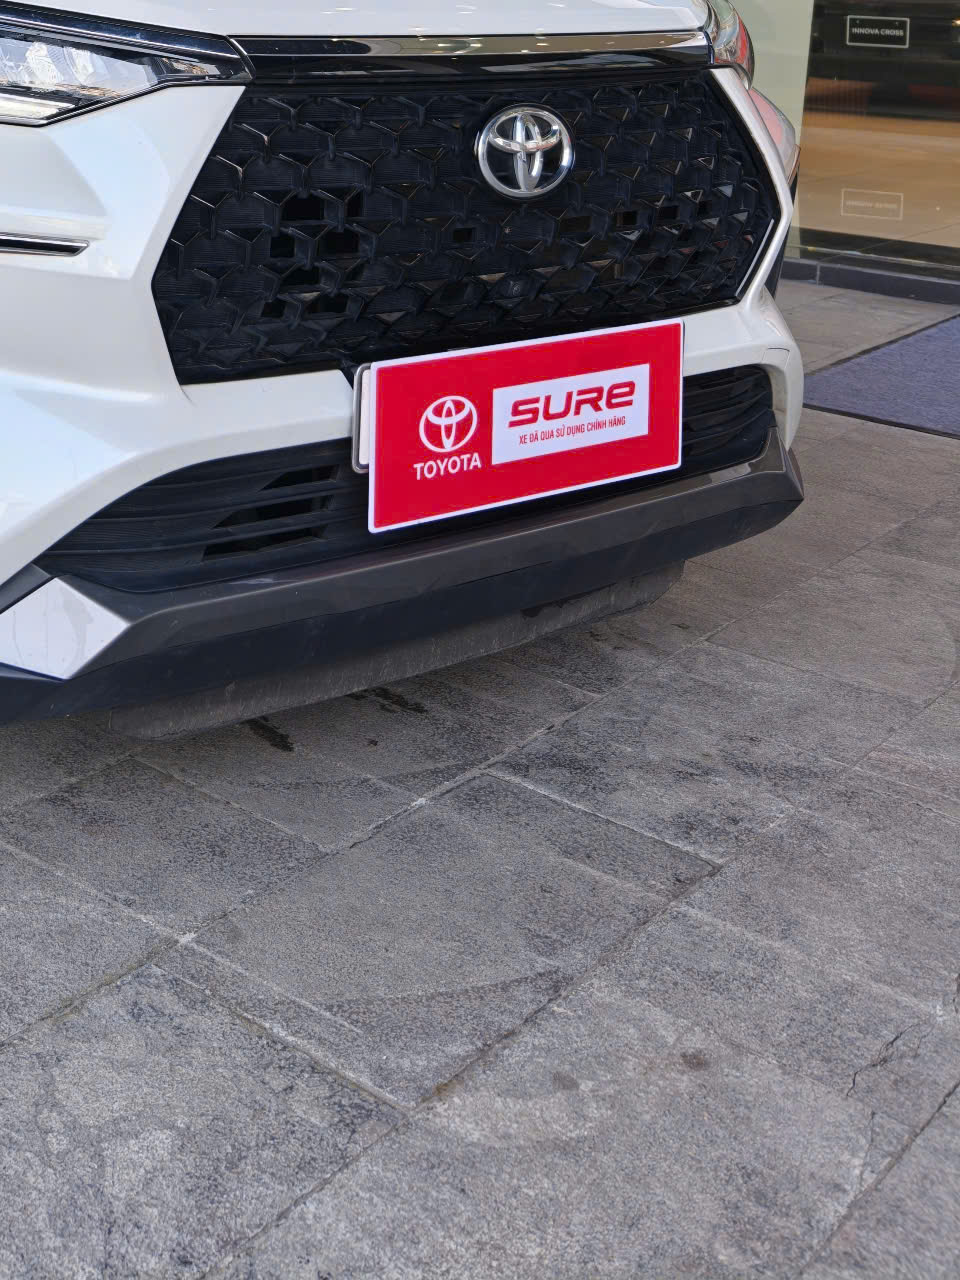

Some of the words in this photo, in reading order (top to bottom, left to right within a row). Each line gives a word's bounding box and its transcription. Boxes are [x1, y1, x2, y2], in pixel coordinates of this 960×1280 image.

[852, 27, 879, 35] INNOVA
[880, 28, 904, 36] CROSS
[519, 435, 527, 445] XE
[529, 430, 539, 442] ĐÃ
[540, 430, 554, 441] QUA
[555, 424, 565, 438] SỬ
[567, 424, 586, 437] DỤNG
[586, 419, 607, 432] CHÍNH
[413, 452, 481, 480] TOYOTA
